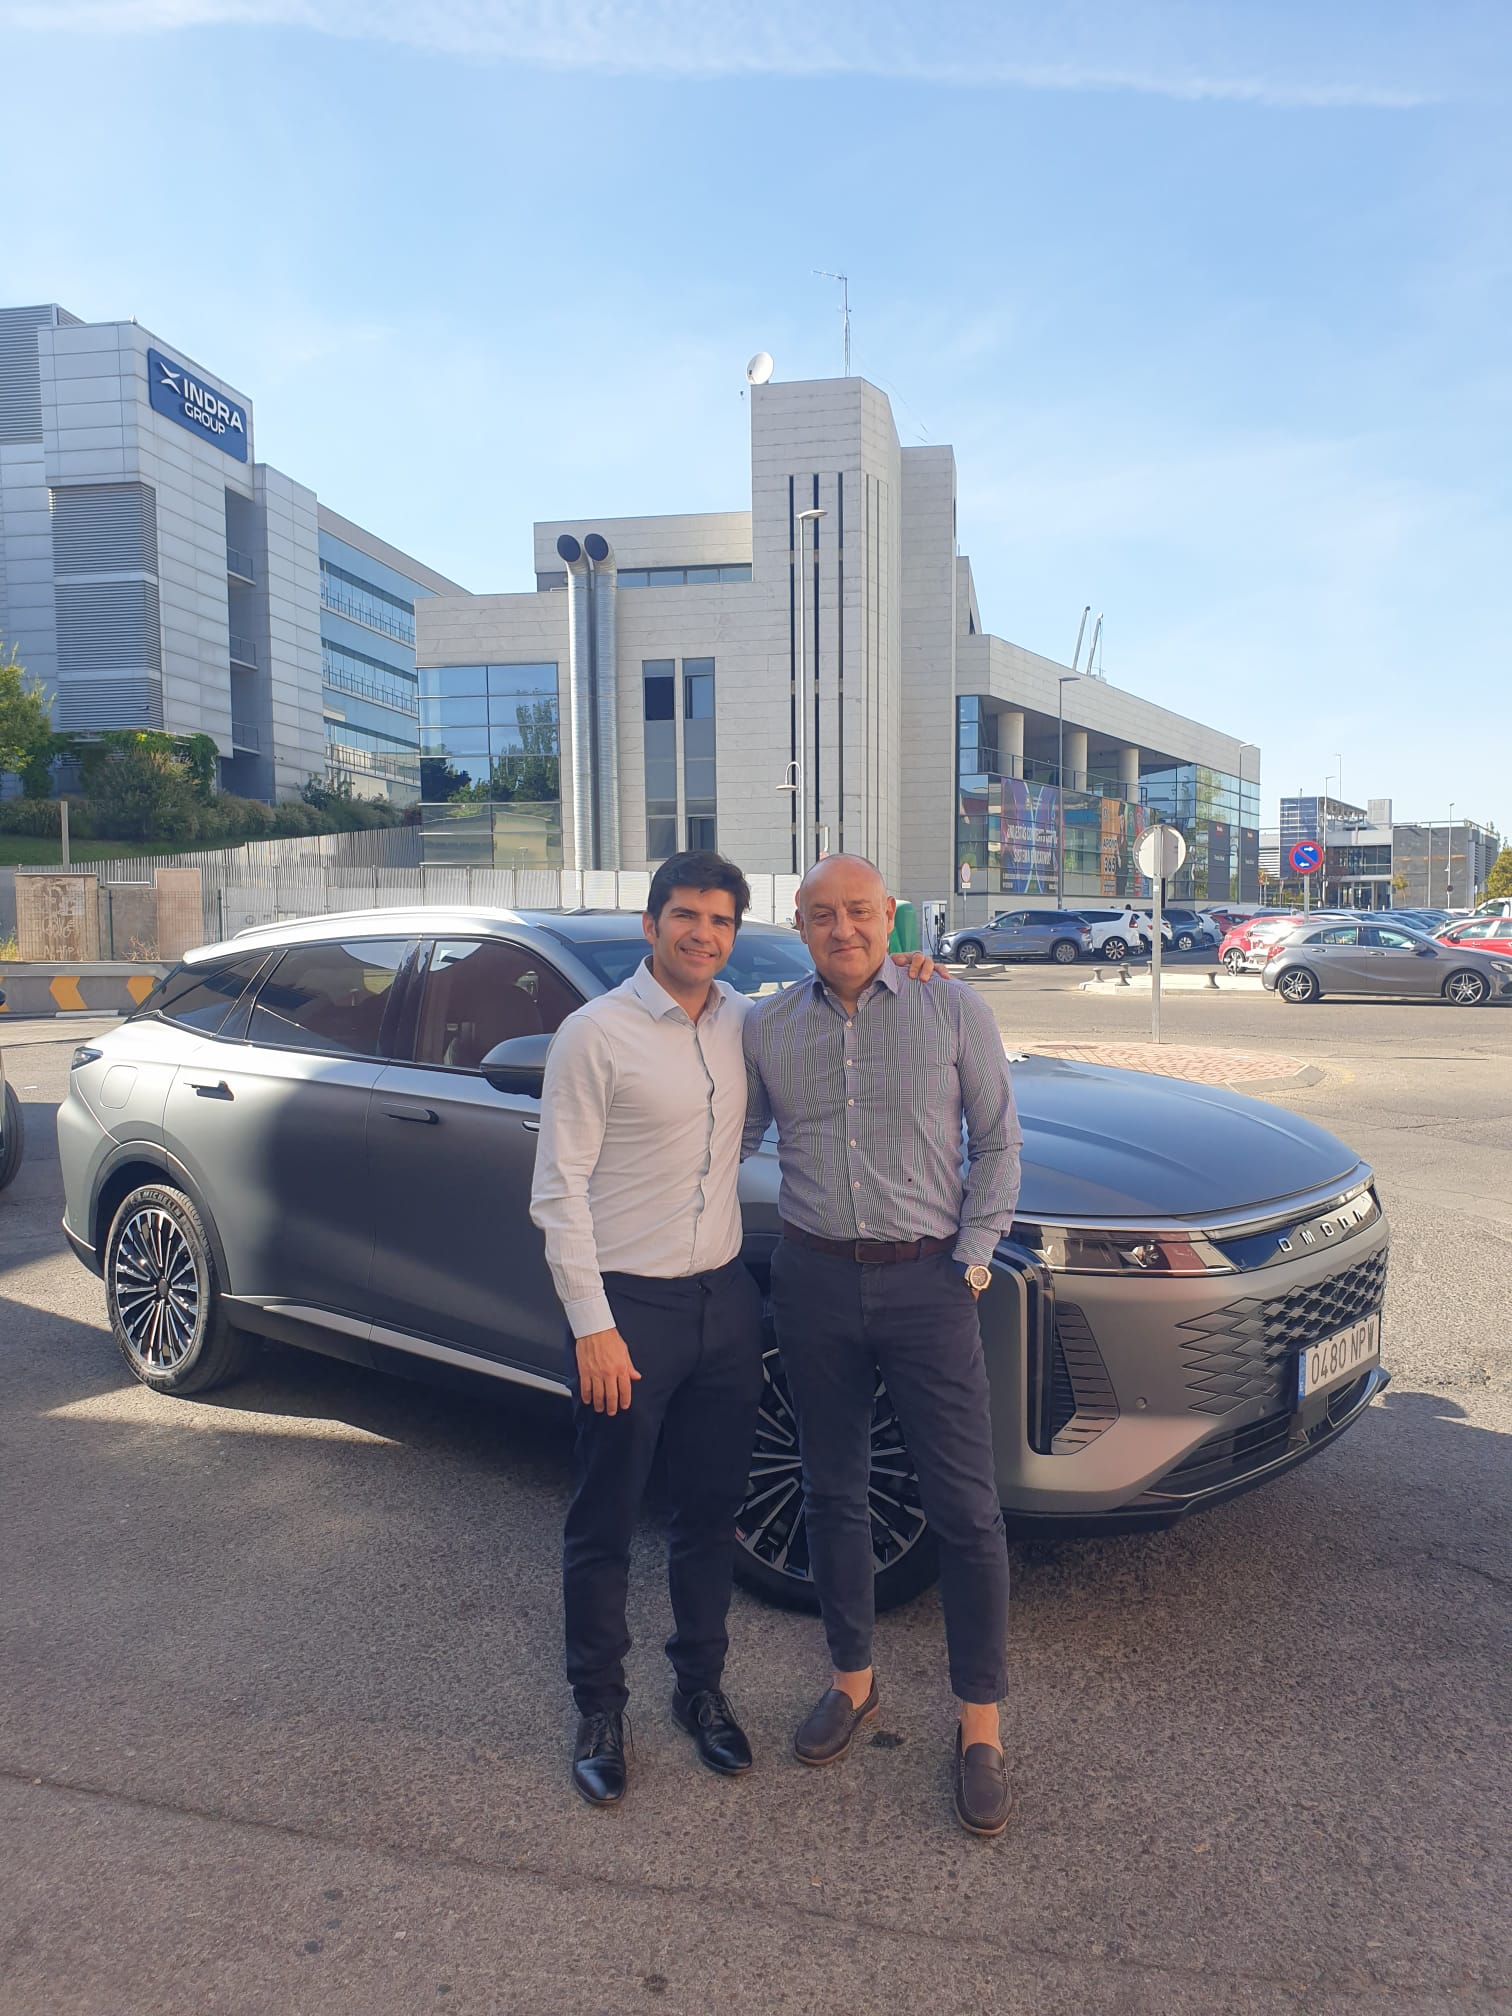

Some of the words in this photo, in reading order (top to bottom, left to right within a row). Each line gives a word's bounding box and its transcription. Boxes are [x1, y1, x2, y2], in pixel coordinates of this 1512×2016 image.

[183, 378, 244, 433] INDRA
[184, 402, 226, 435] GROUP
[1104, 856, 1116, 873] 365
[143, 1191, 183, 1218] MICHELIN
[1311, 1338, 1346, 1385] 0480
[1350, 1321, 1375, 1364] NPW
